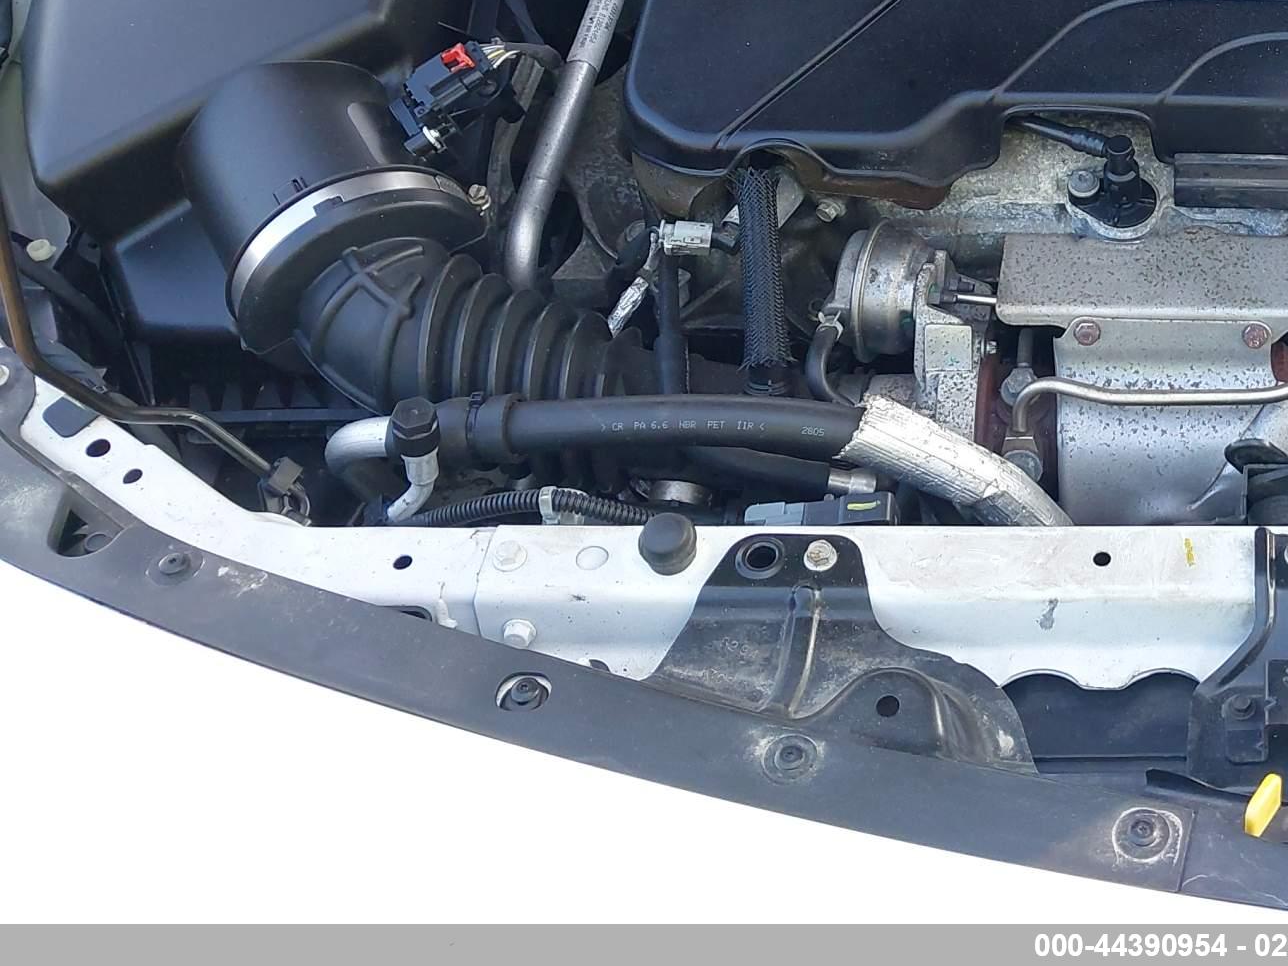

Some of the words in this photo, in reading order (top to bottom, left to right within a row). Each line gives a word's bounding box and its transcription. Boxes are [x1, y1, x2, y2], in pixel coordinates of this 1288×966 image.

[611, 422, 624, 432] CR
[633, 421, 647, 431] PA
[706, 420, 726, 430] PET
[801, 425, 825, 437] 2805
